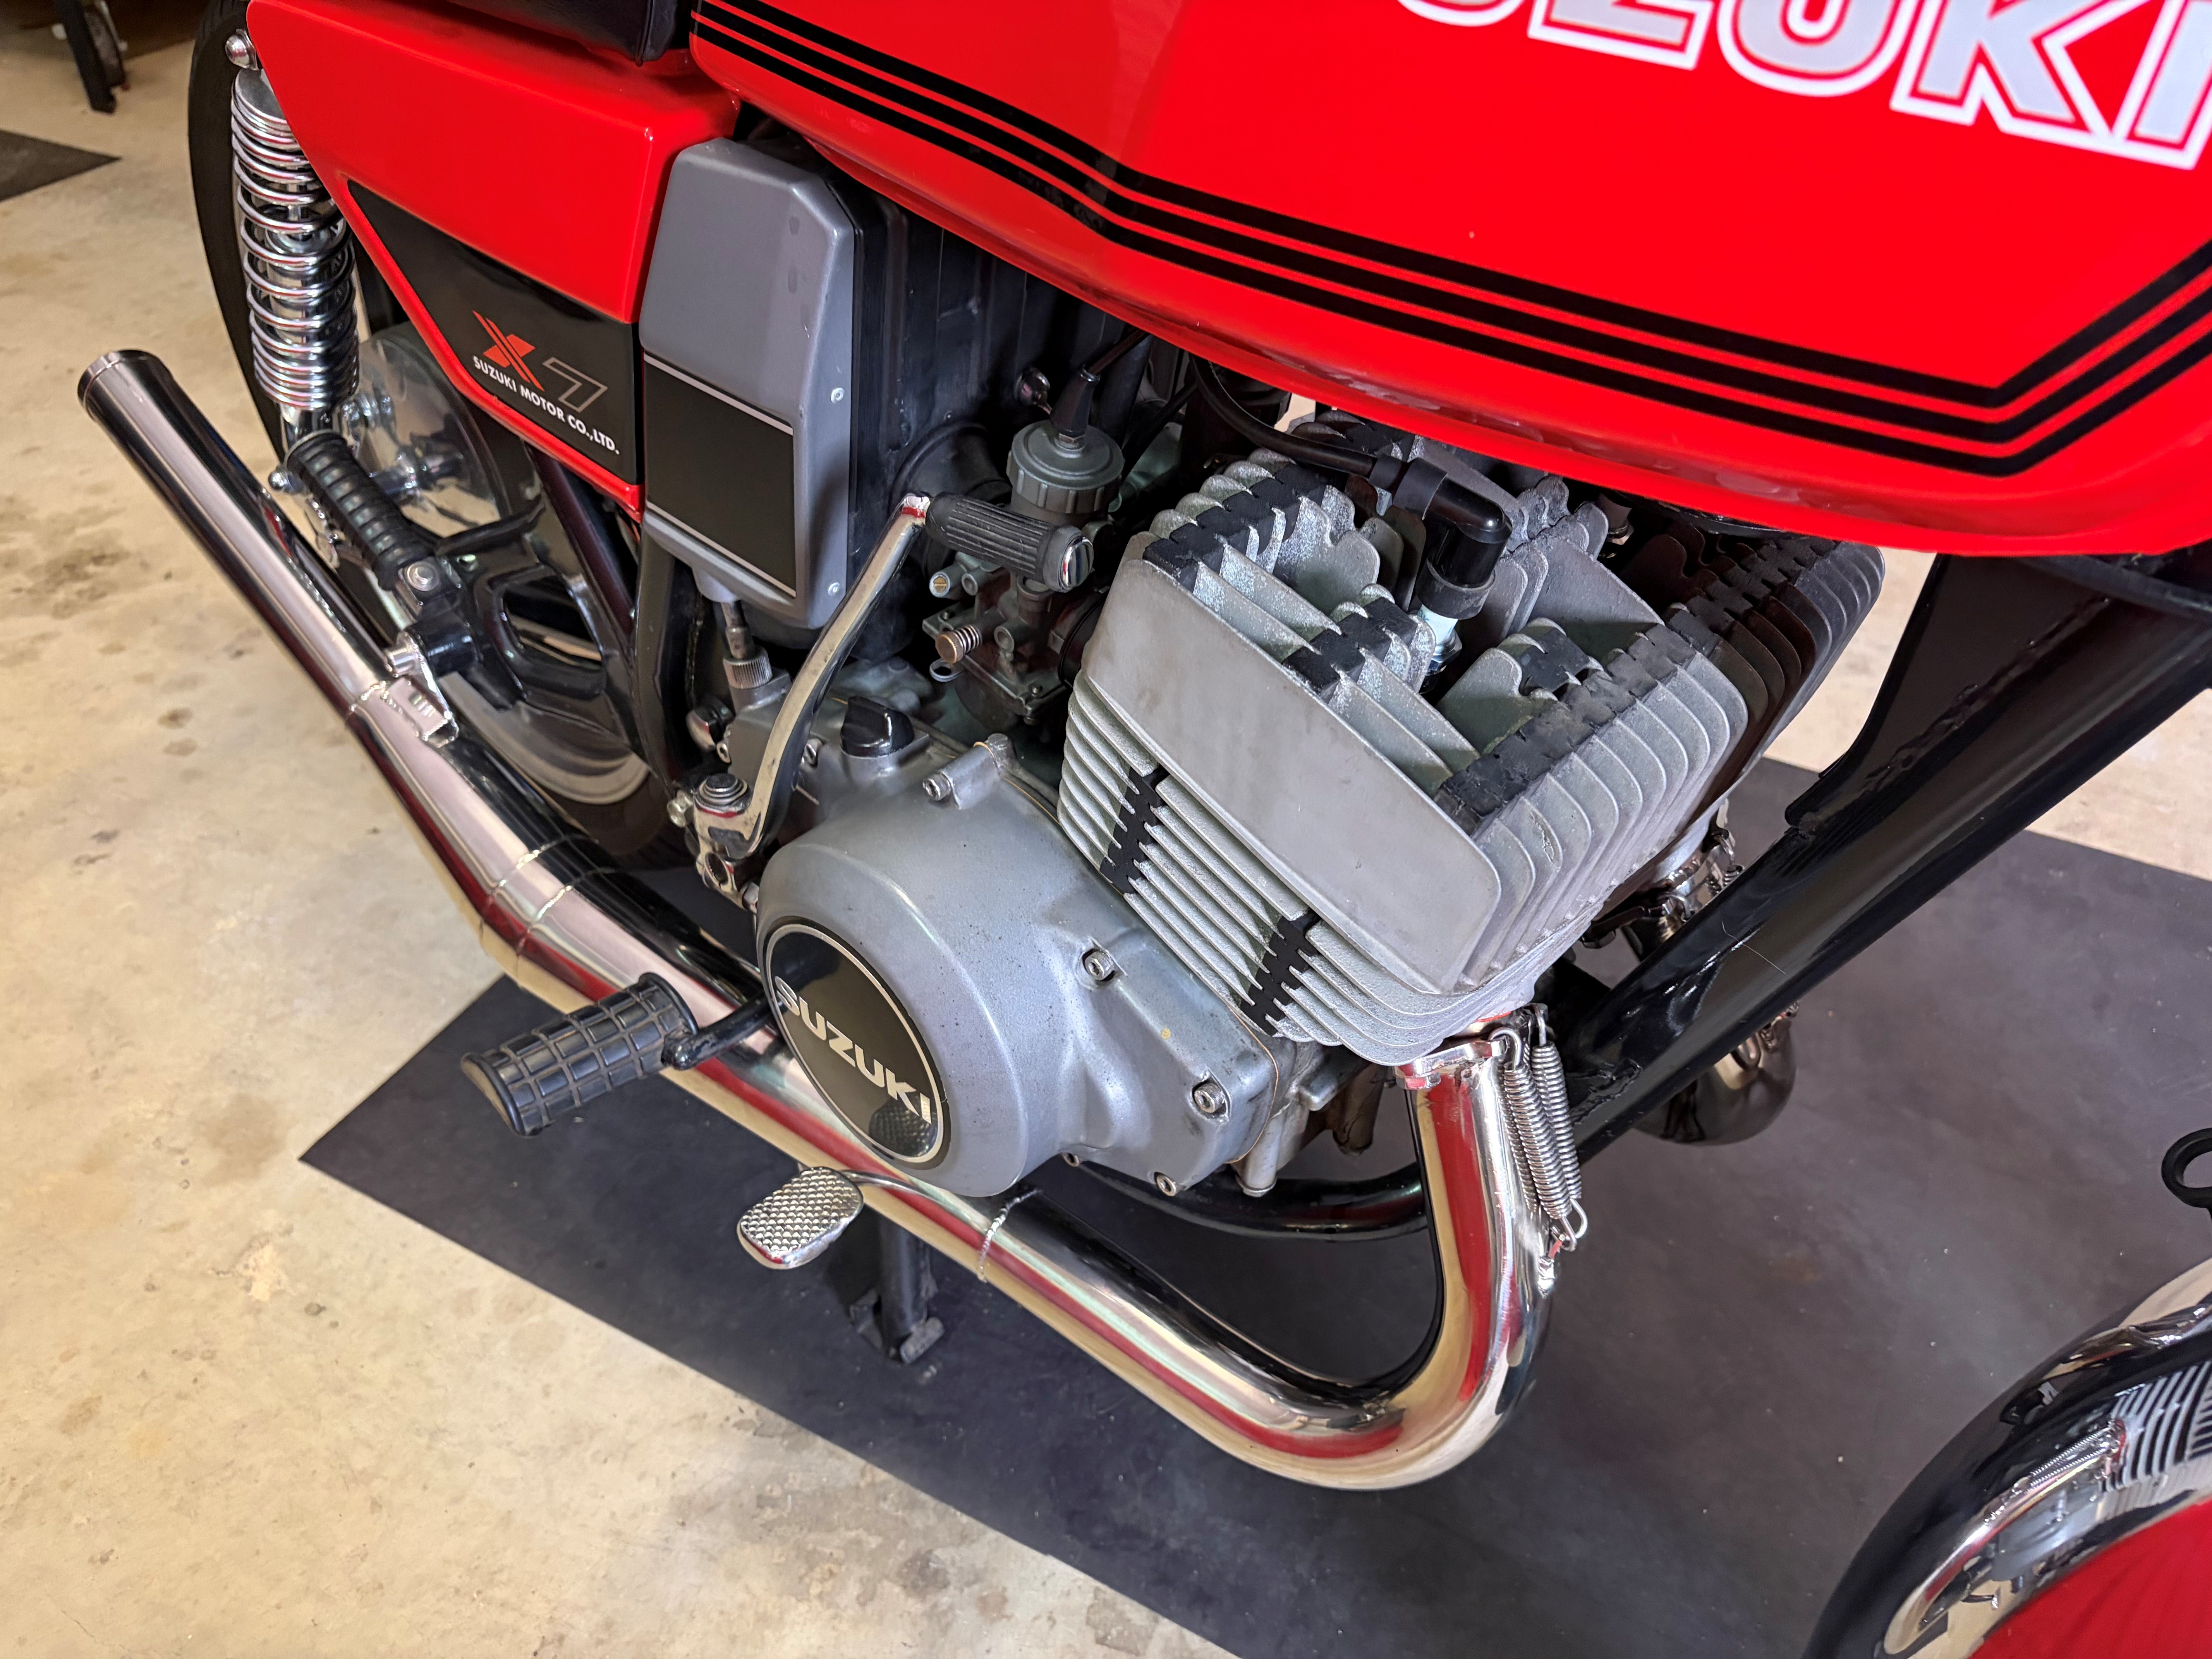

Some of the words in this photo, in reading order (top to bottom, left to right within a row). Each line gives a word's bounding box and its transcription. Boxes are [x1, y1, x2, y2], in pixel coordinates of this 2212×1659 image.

[473, 356, 517, 392] SUZUKI
[520, 385, 565, 422] MOTOR
[775, 976, 932, 1125] SUZUKI
